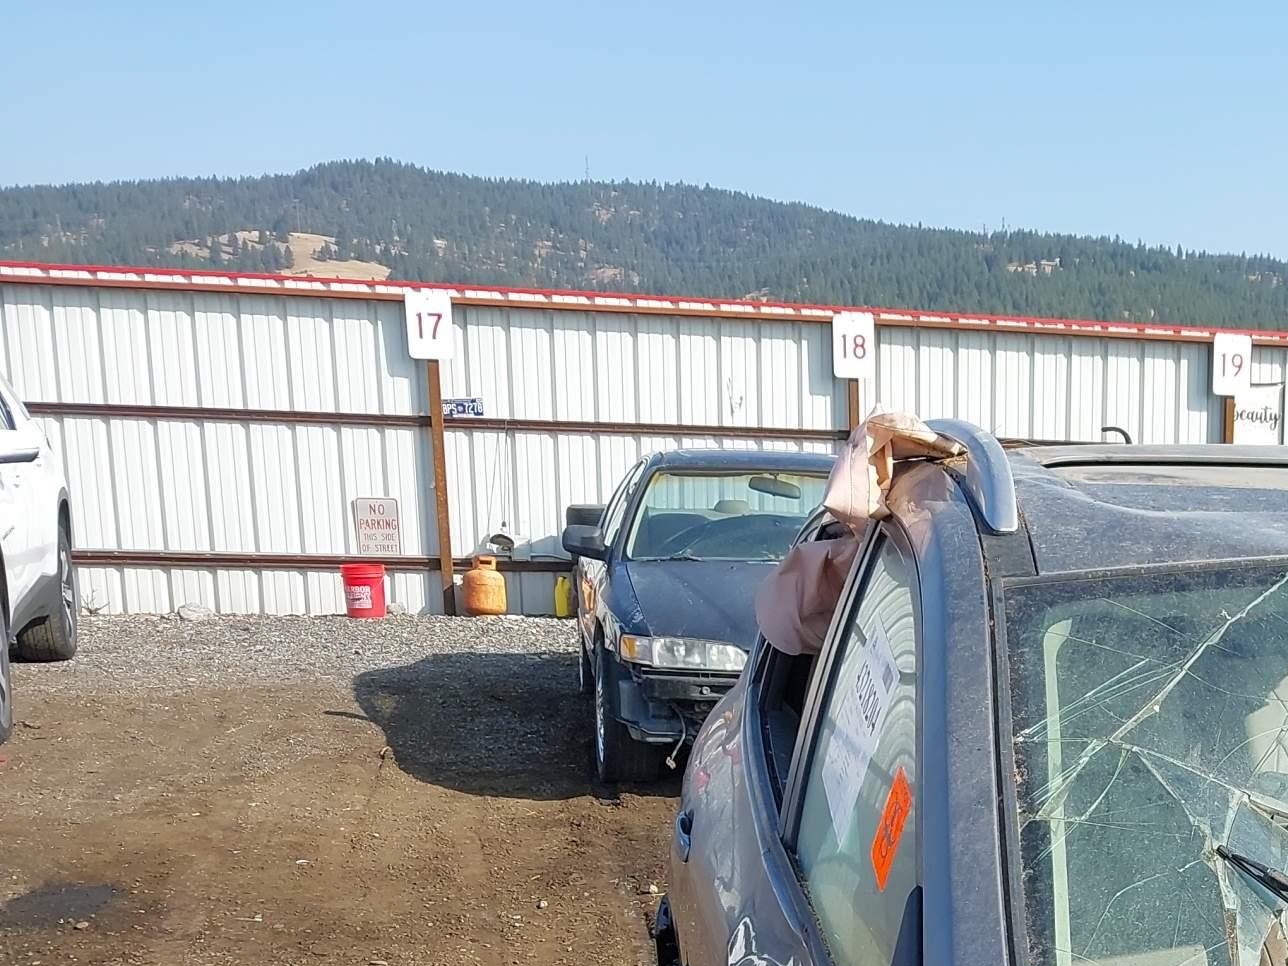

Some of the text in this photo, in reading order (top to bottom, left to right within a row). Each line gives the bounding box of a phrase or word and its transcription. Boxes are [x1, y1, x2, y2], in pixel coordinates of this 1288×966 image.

[416, 312, 443, 340] 17
[841, 333, 866, 359] 18
[1221, 353, 1243, 377] 19
[369, 503, 385, 516] NO
[359, 518, 397, 531] PARKING
[381, 532, 395, 542] SIDE
[361, 543, 372, 553] OF
[856, 660, 882, 737] 43218204
